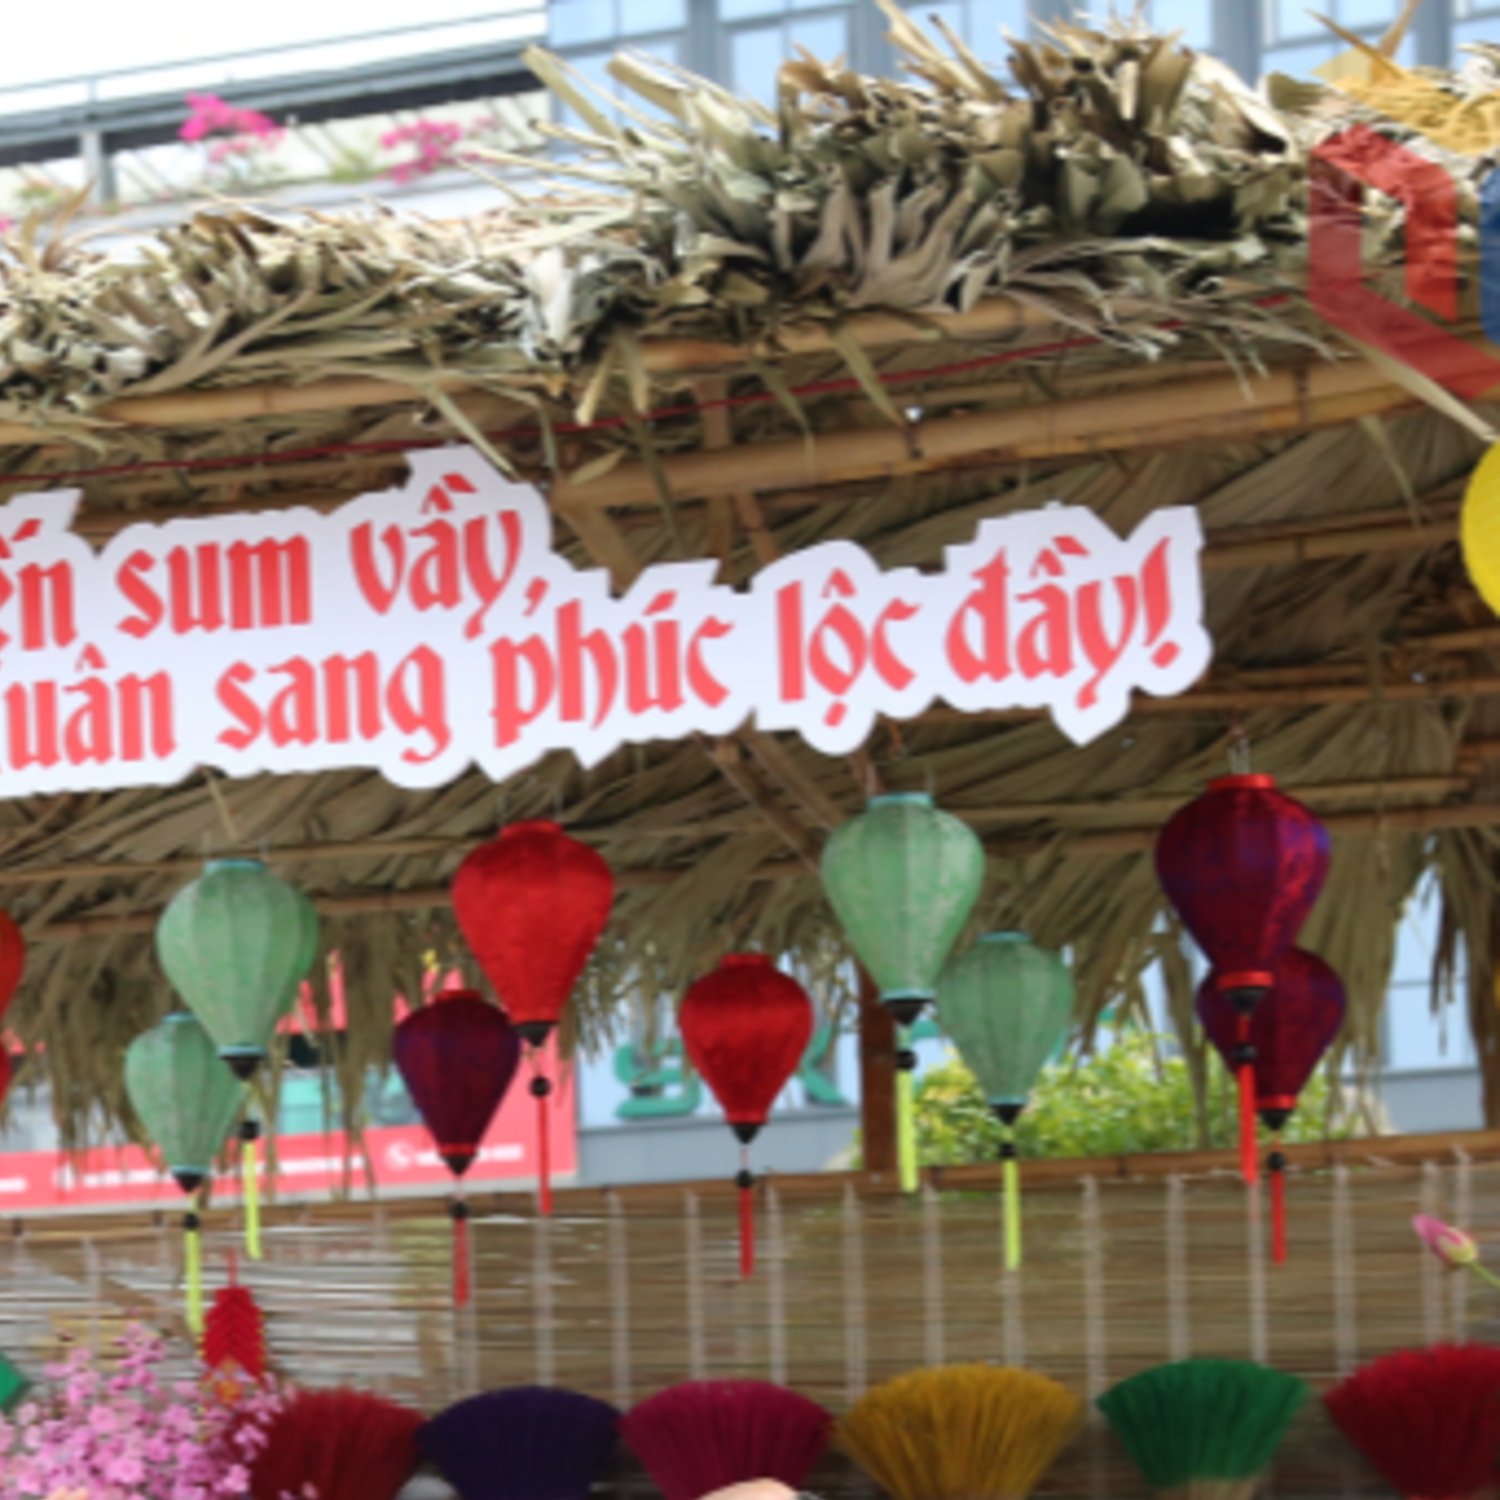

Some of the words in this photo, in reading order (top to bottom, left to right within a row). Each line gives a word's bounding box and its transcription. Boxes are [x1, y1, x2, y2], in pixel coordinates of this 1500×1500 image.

[116, 534, 313, 639] sum
[350, 472, 548, 640] vầy,
[216, 642, 451, 764] sang
[489, 590, 733, 749] phúc
[777, 566, 921, 728] lộc
[945, 534, 1182, 710] đầy!
